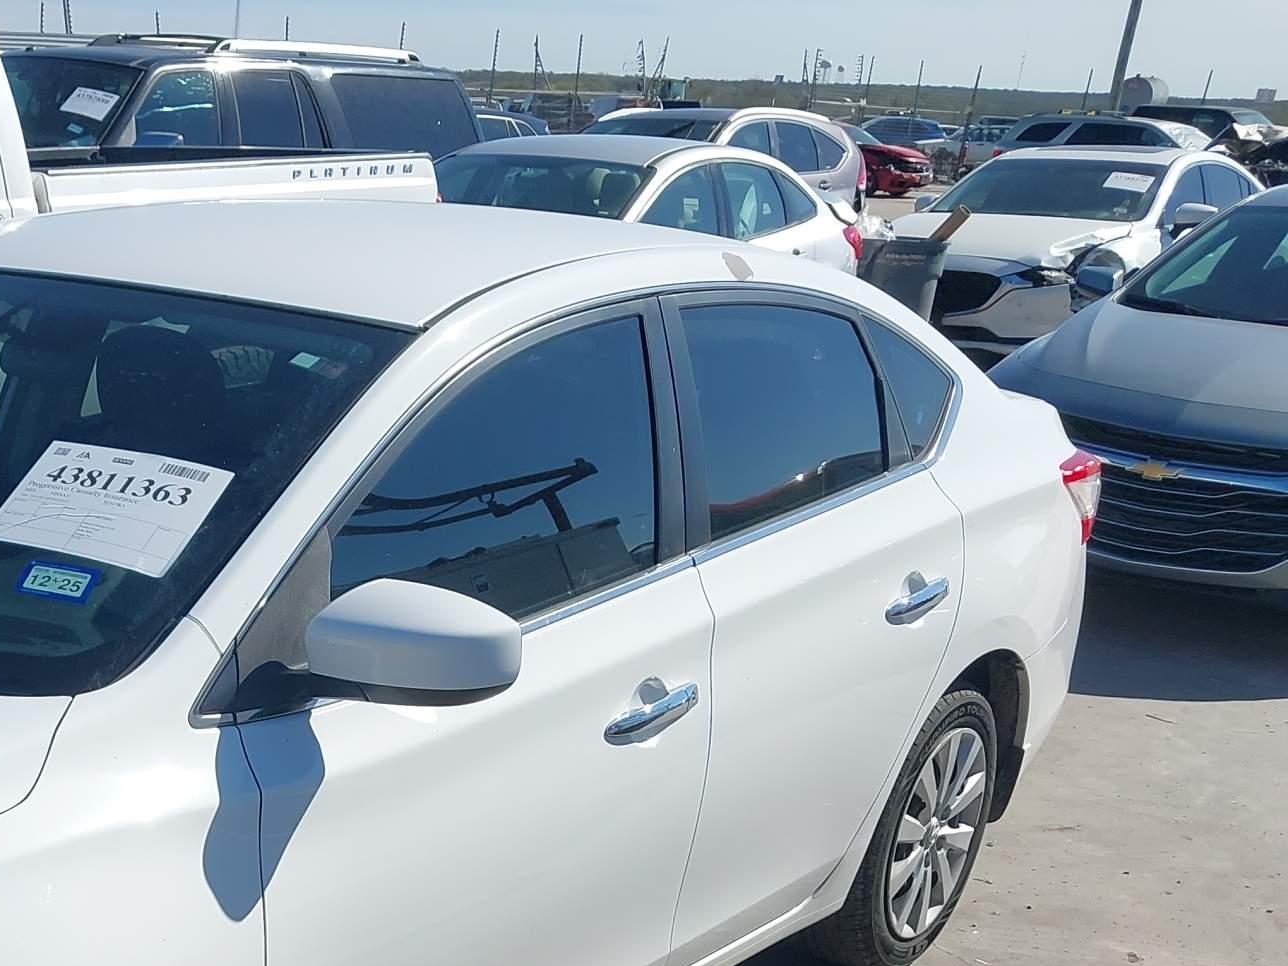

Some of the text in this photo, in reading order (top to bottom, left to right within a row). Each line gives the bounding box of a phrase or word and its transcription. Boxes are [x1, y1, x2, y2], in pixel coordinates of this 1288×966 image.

[292, 163, 414, 180] PLATINUM
[28, 480, 71, 493] Progressive
[71, 486, 102, 499] Casualty
[104, 492, 140, 505] Insurance
[46, 465, 192, 506] 43811363
[28, 574, 52, 588] 12
[57, 578, 83, 593] 25
